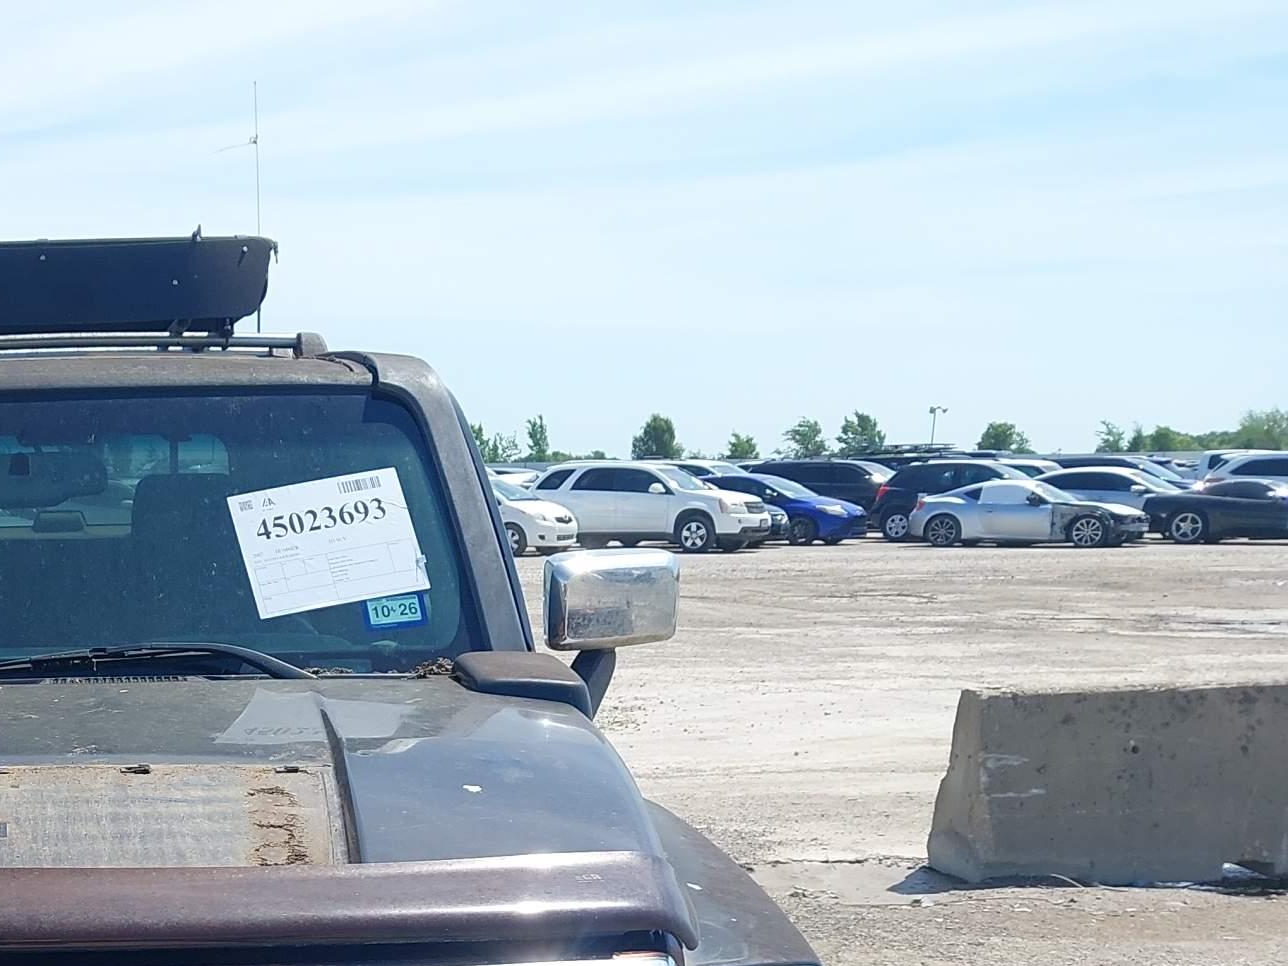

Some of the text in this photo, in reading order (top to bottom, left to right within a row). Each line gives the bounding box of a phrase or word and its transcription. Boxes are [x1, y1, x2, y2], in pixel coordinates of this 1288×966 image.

[256, 497, 387, 540] 45023693
[371, 602, 418, 619] 10 26
